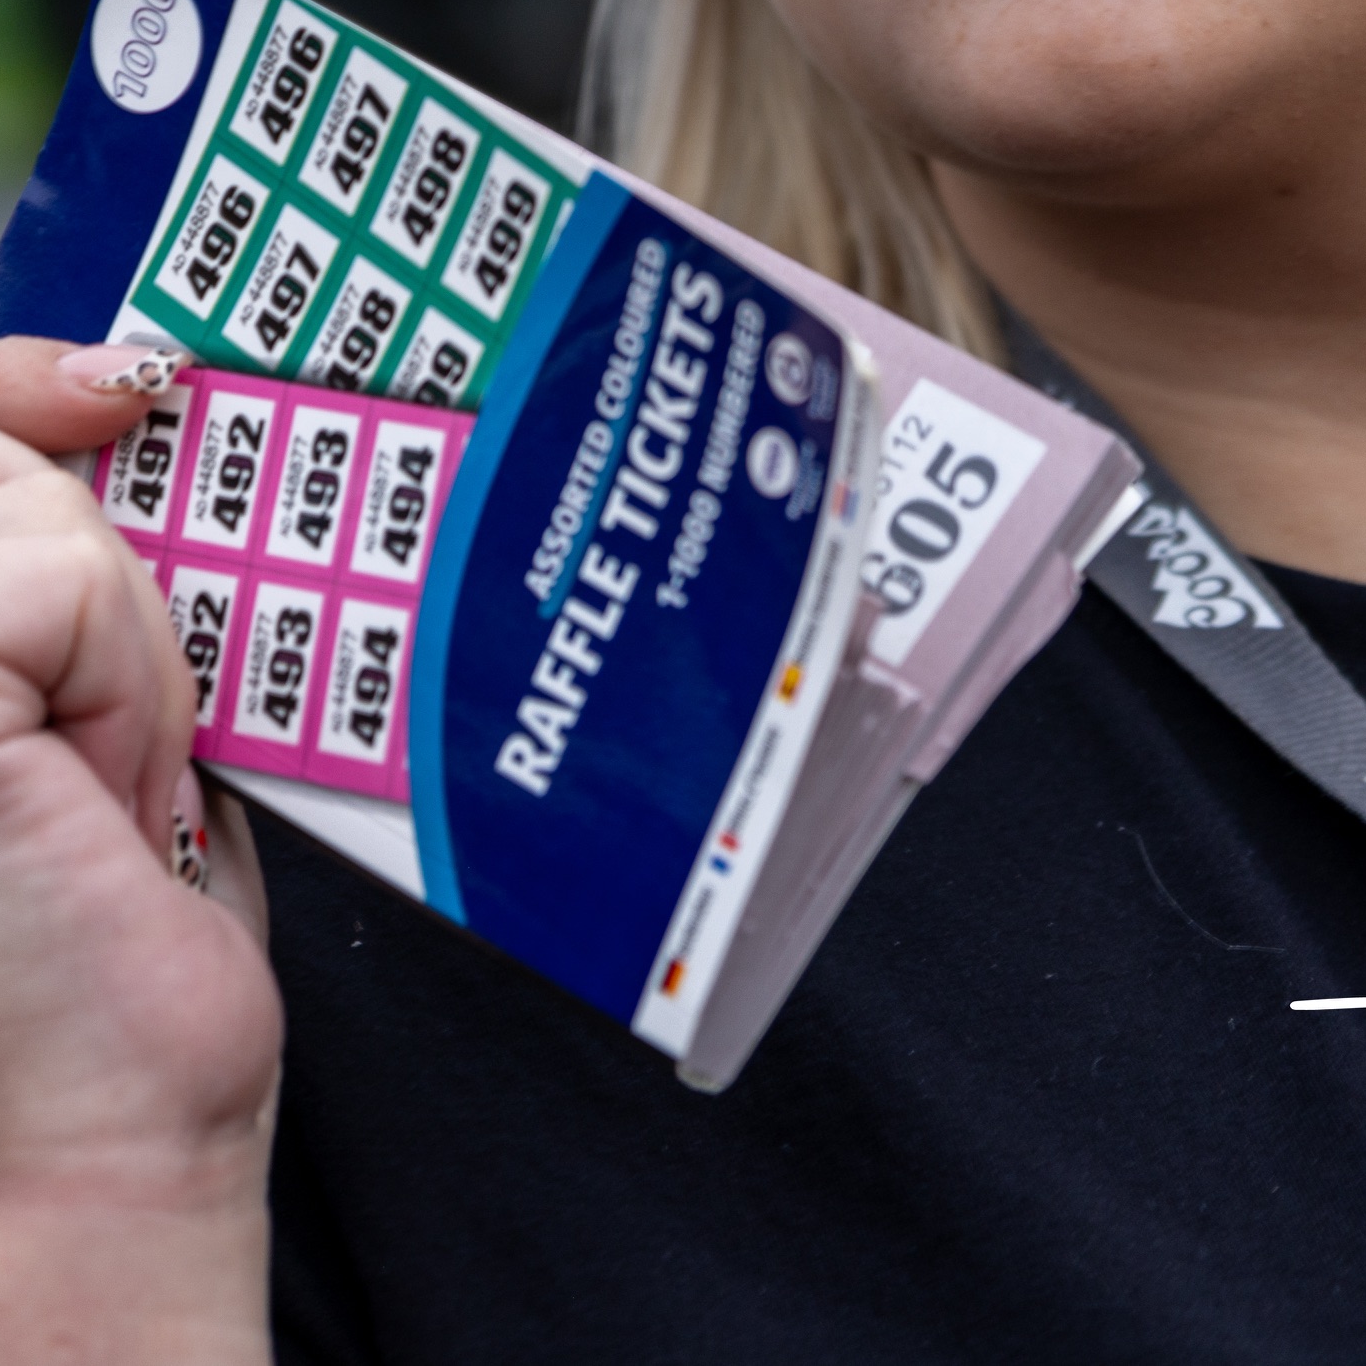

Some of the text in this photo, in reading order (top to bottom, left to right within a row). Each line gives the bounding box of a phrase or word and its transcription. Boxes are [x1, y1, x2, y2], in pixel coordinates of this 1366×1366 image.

[259, 26, 325, 146] 496
[331, 83, 391, 196] 497
[187, 186, 255, 302] 496
[401, 129, 467, 248] 498
[475, 180, 537, 299] 499
[255, 242, 320, 354] 497
[412, 340, 469, 406] 99
[524, 236, 668, 601] ASSORTED COLOURED
[129, 409, 181, 519] 491
[212, 414, 265, 533] 492
[296, 429, 349, 550] 493
[383, 447, 435, 568] 494
[656, 298, 766, 610] 1-1000 NUMBERED
[494, 261, 724, 797] RAFFLE TICKETS
[860, 439, 1000, 619] 605
[262, 607, 313, 731] 493
[348, 627, 399, 749] 494
